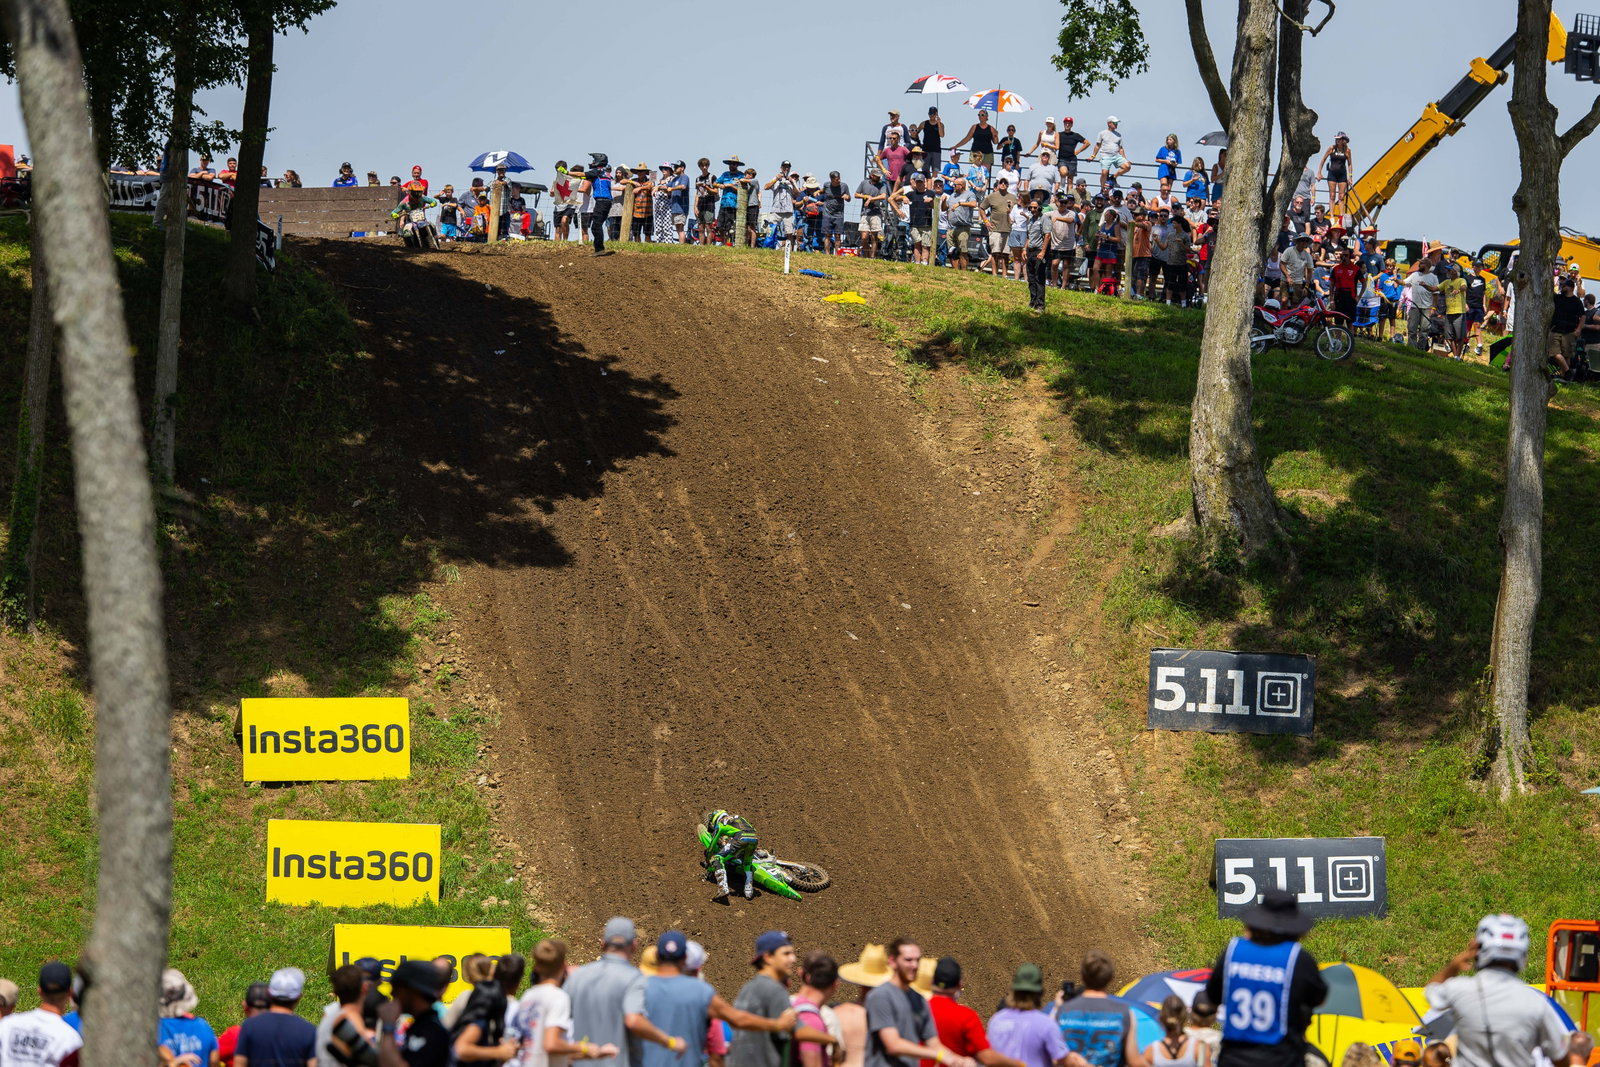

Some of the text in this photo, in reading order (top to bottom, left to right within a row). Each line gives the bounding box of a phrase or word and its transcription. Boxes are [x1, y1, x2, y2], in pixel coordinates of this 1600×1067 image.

[195, 185, 219, 217] 5.11
[1154, 666, 1250, 716] 5.11
[249, 723, 405, 754] Insta360
[272, 847, 433, 883] Insta360
[1229, 961, 1285, 984] PRESS
[1229, 987, 1276, 1032] 39
